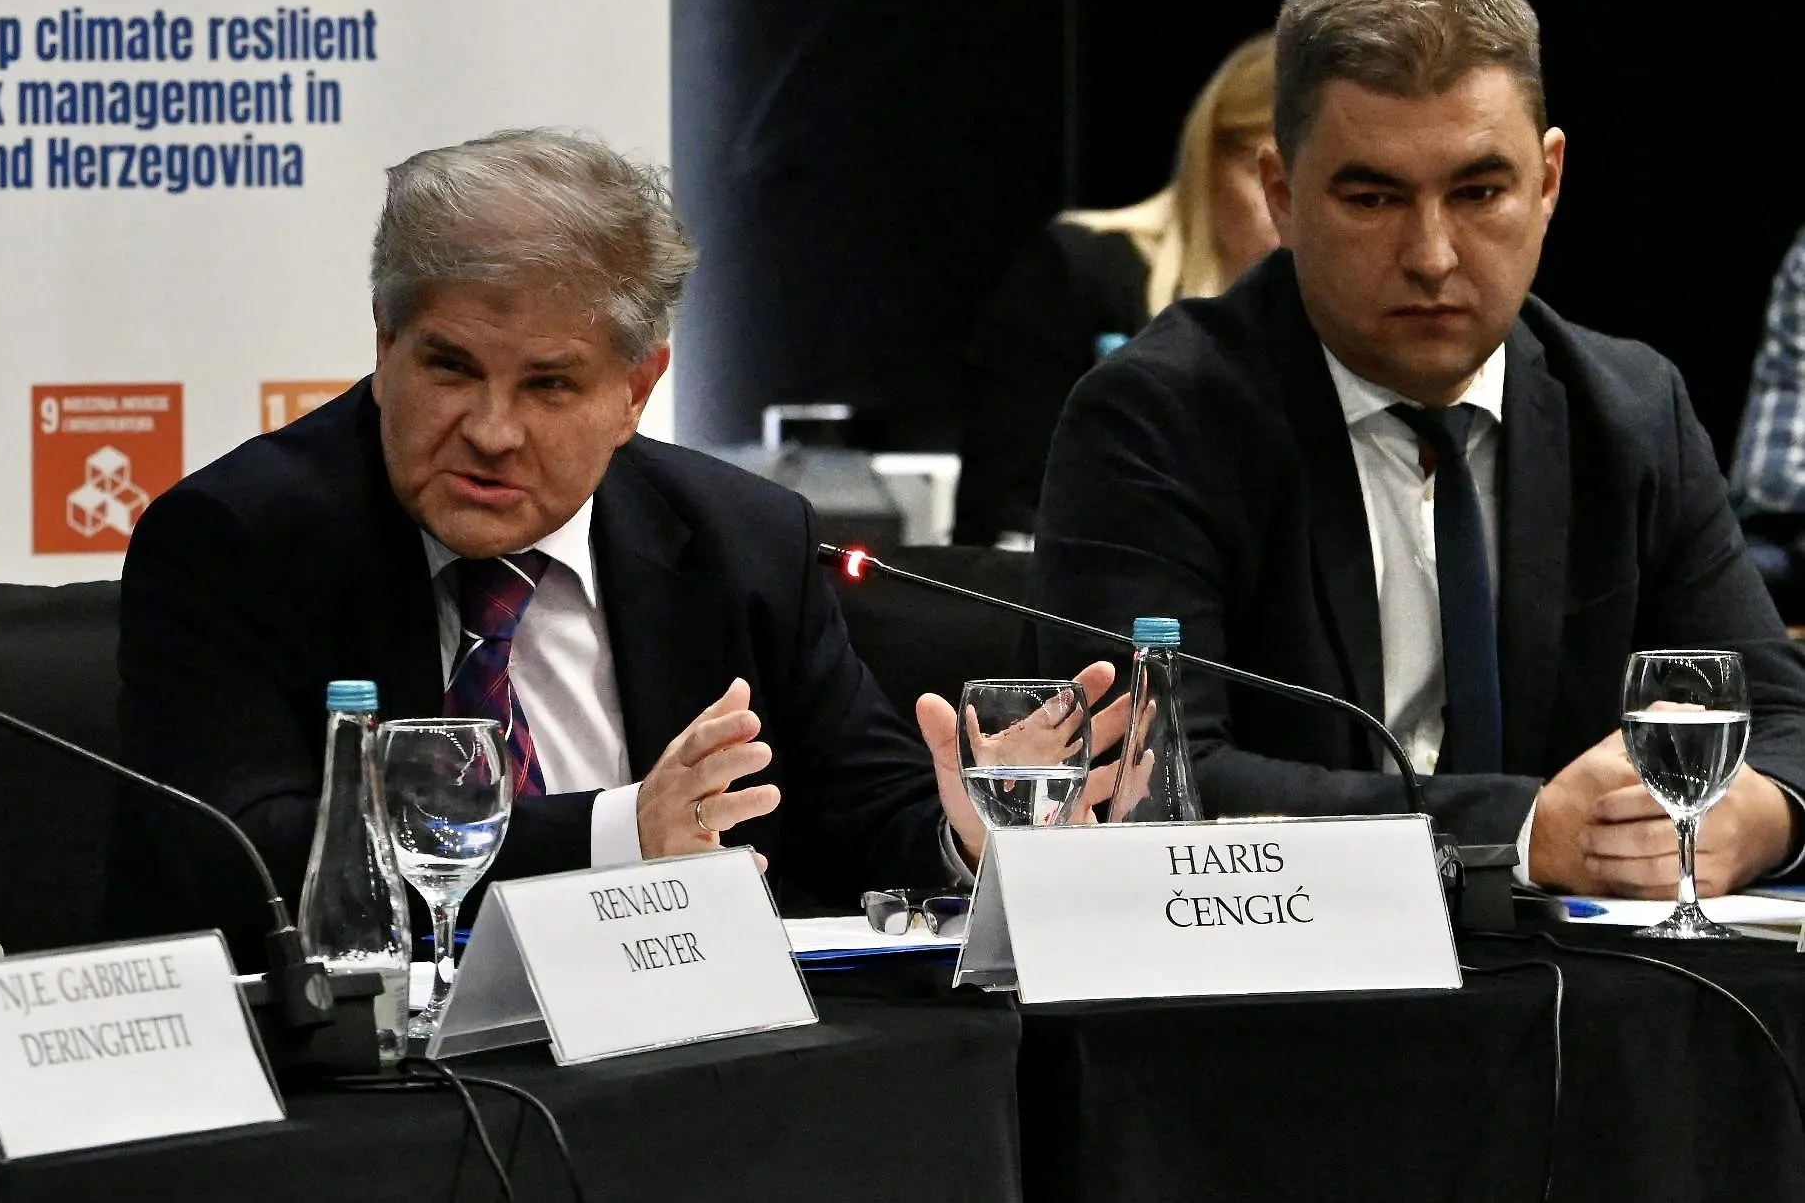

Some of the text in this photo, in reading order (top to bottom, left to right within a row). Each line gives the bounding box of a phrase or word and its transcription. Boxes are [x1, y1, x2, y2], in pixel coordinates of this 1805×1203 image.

[35, 7, 193, 62] climate
[208, 6, 377, 62] resilient
[18, 72, 293, 131] management
[306, 70, 341, 124] in
[47, 133, 304, 195] Herzegovina
[39, 395, 61, 435] 9
[1165, 842, 1284, 876] HARIS
[589, 879, 689, 922] RENAUD
[1165, 885, 1314, 928] ČENGIĆ
[621, 932, 706, 973] MEYER
[57, 955, 182, 1003] GABRIELE
[19, 1013, 192, 1068] DERINGHETTI
